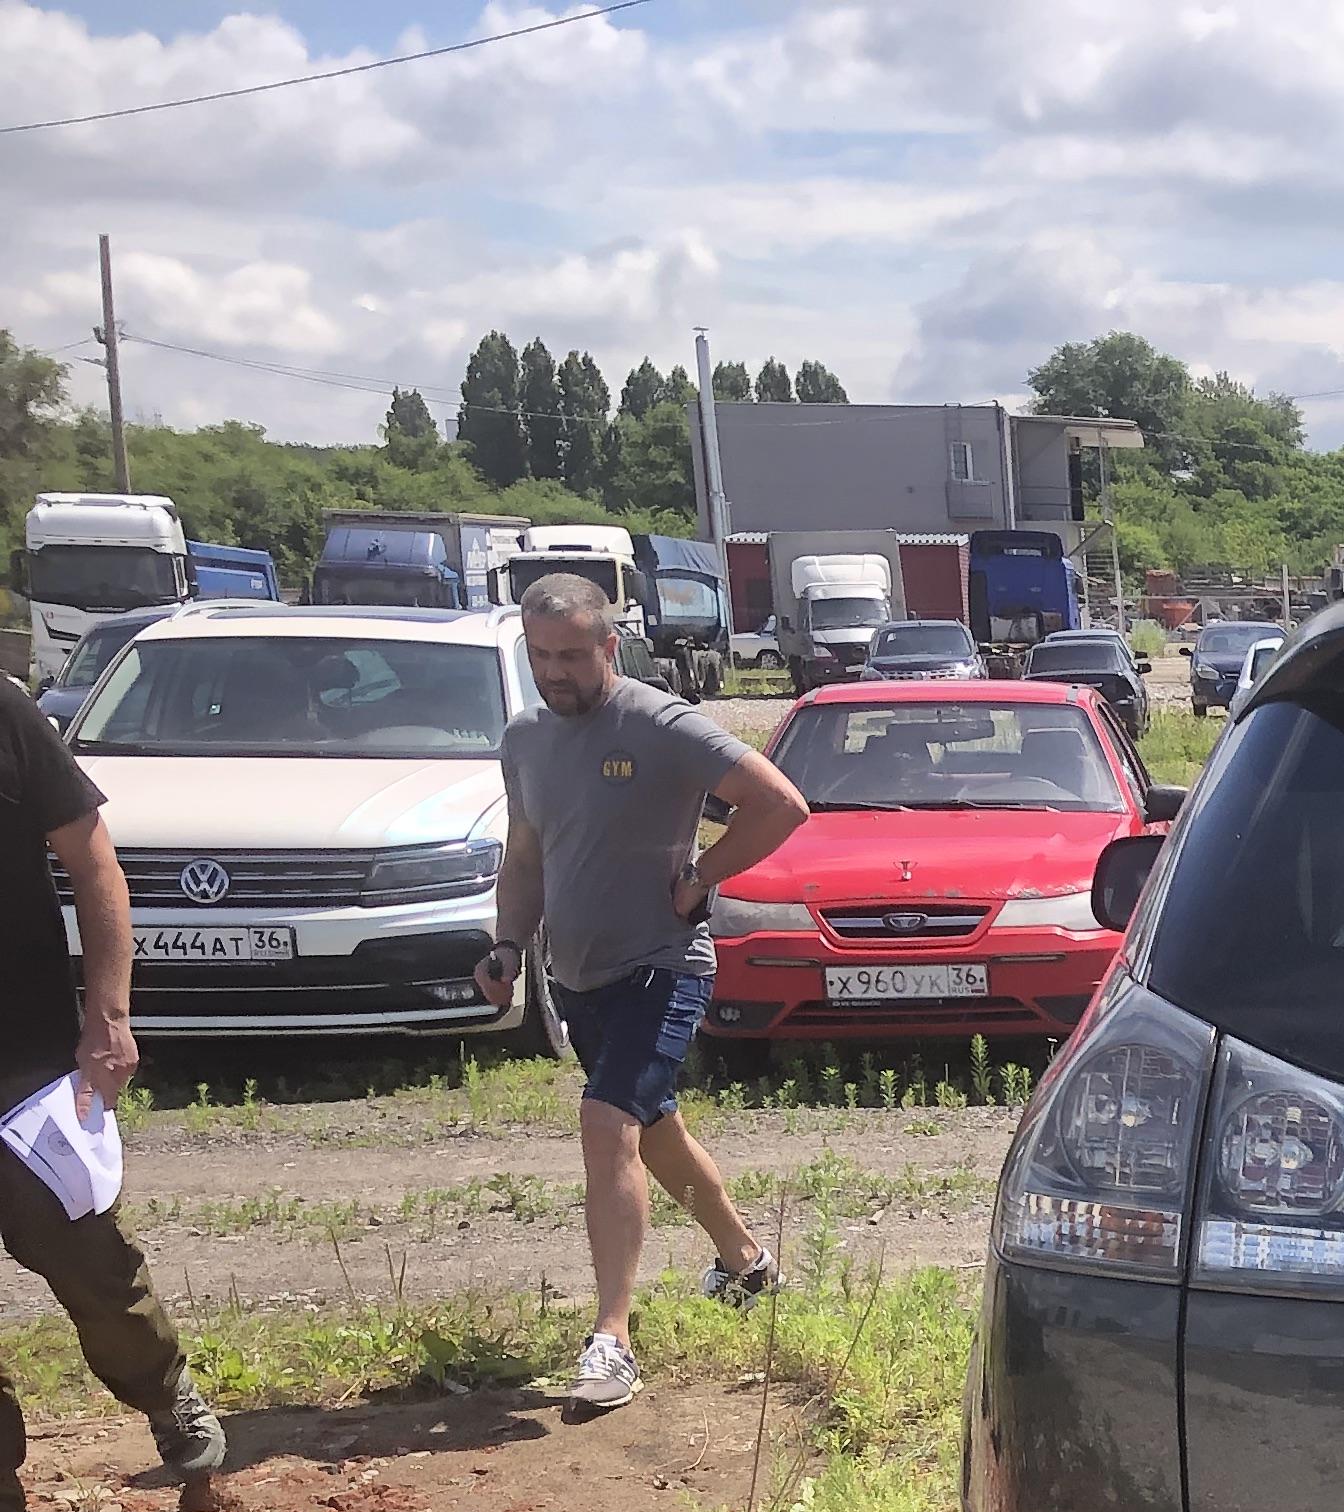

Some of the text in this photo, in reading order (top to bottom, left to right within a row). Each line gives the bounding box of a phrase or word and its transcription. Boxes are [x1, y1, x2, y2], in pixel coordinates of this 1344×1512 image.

[602, 760, 633, 777] GYM
[254, 930, 281, 949] 36
[952, 967, 977, 985] 36
